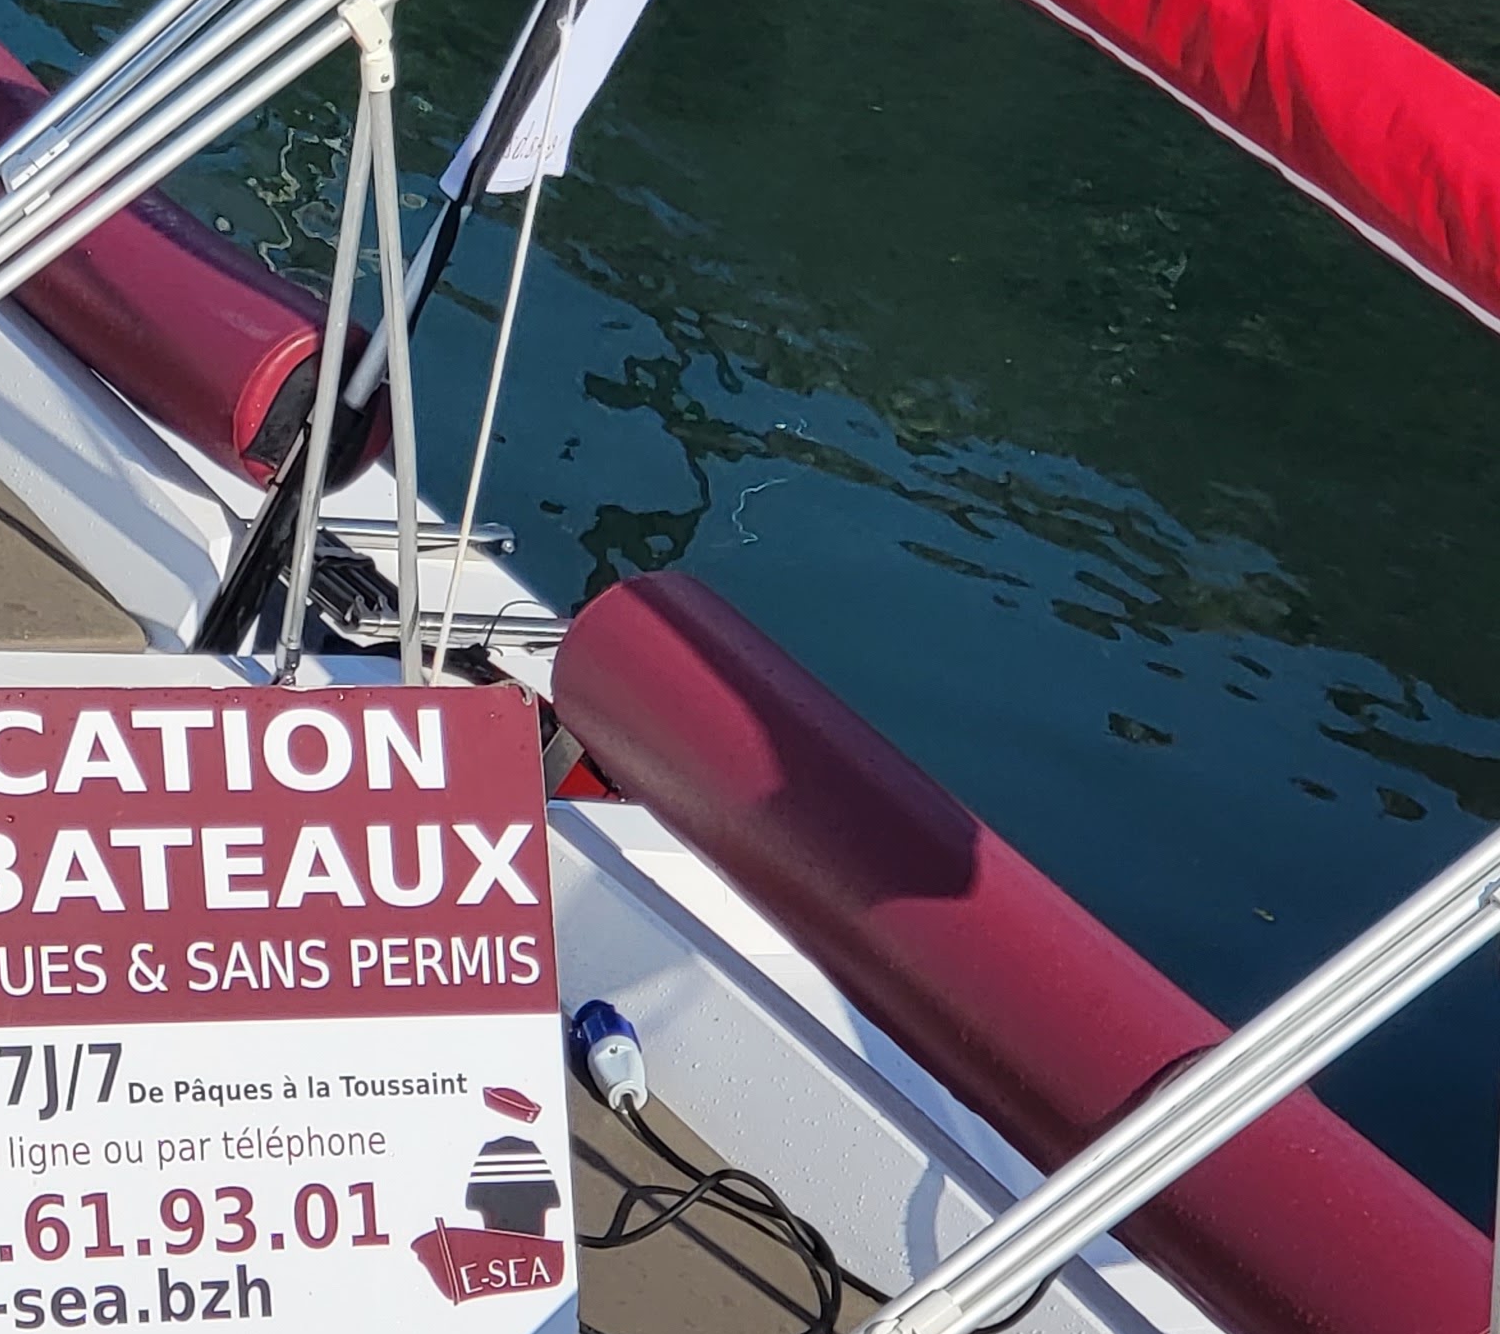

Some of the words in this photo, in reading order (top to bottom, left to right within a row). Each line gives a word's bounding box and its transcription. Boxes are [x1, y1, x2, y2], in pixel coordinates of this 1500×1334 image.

[128, 942, 168, 993] &
[186, 939, 330, 991] SANS
[350, 935, 540, 987] PERMIS
[128, 1082, 164, 1104] De
[174, 1078, 273, 1108] Pâques
[283, 1075, 297, 1099] à
[307, 1075, 330, 1099] la
[338, 1073, 468, 1098] Toussaint
[9, 1136, 91, 1175] ligne
[104, 1140, 143, 1164] ou
[157, 1137, 211, 1171] par
[221, 1125, 386, 1166] téléphone
[460, 1257, 551, 1294] E-SEA
